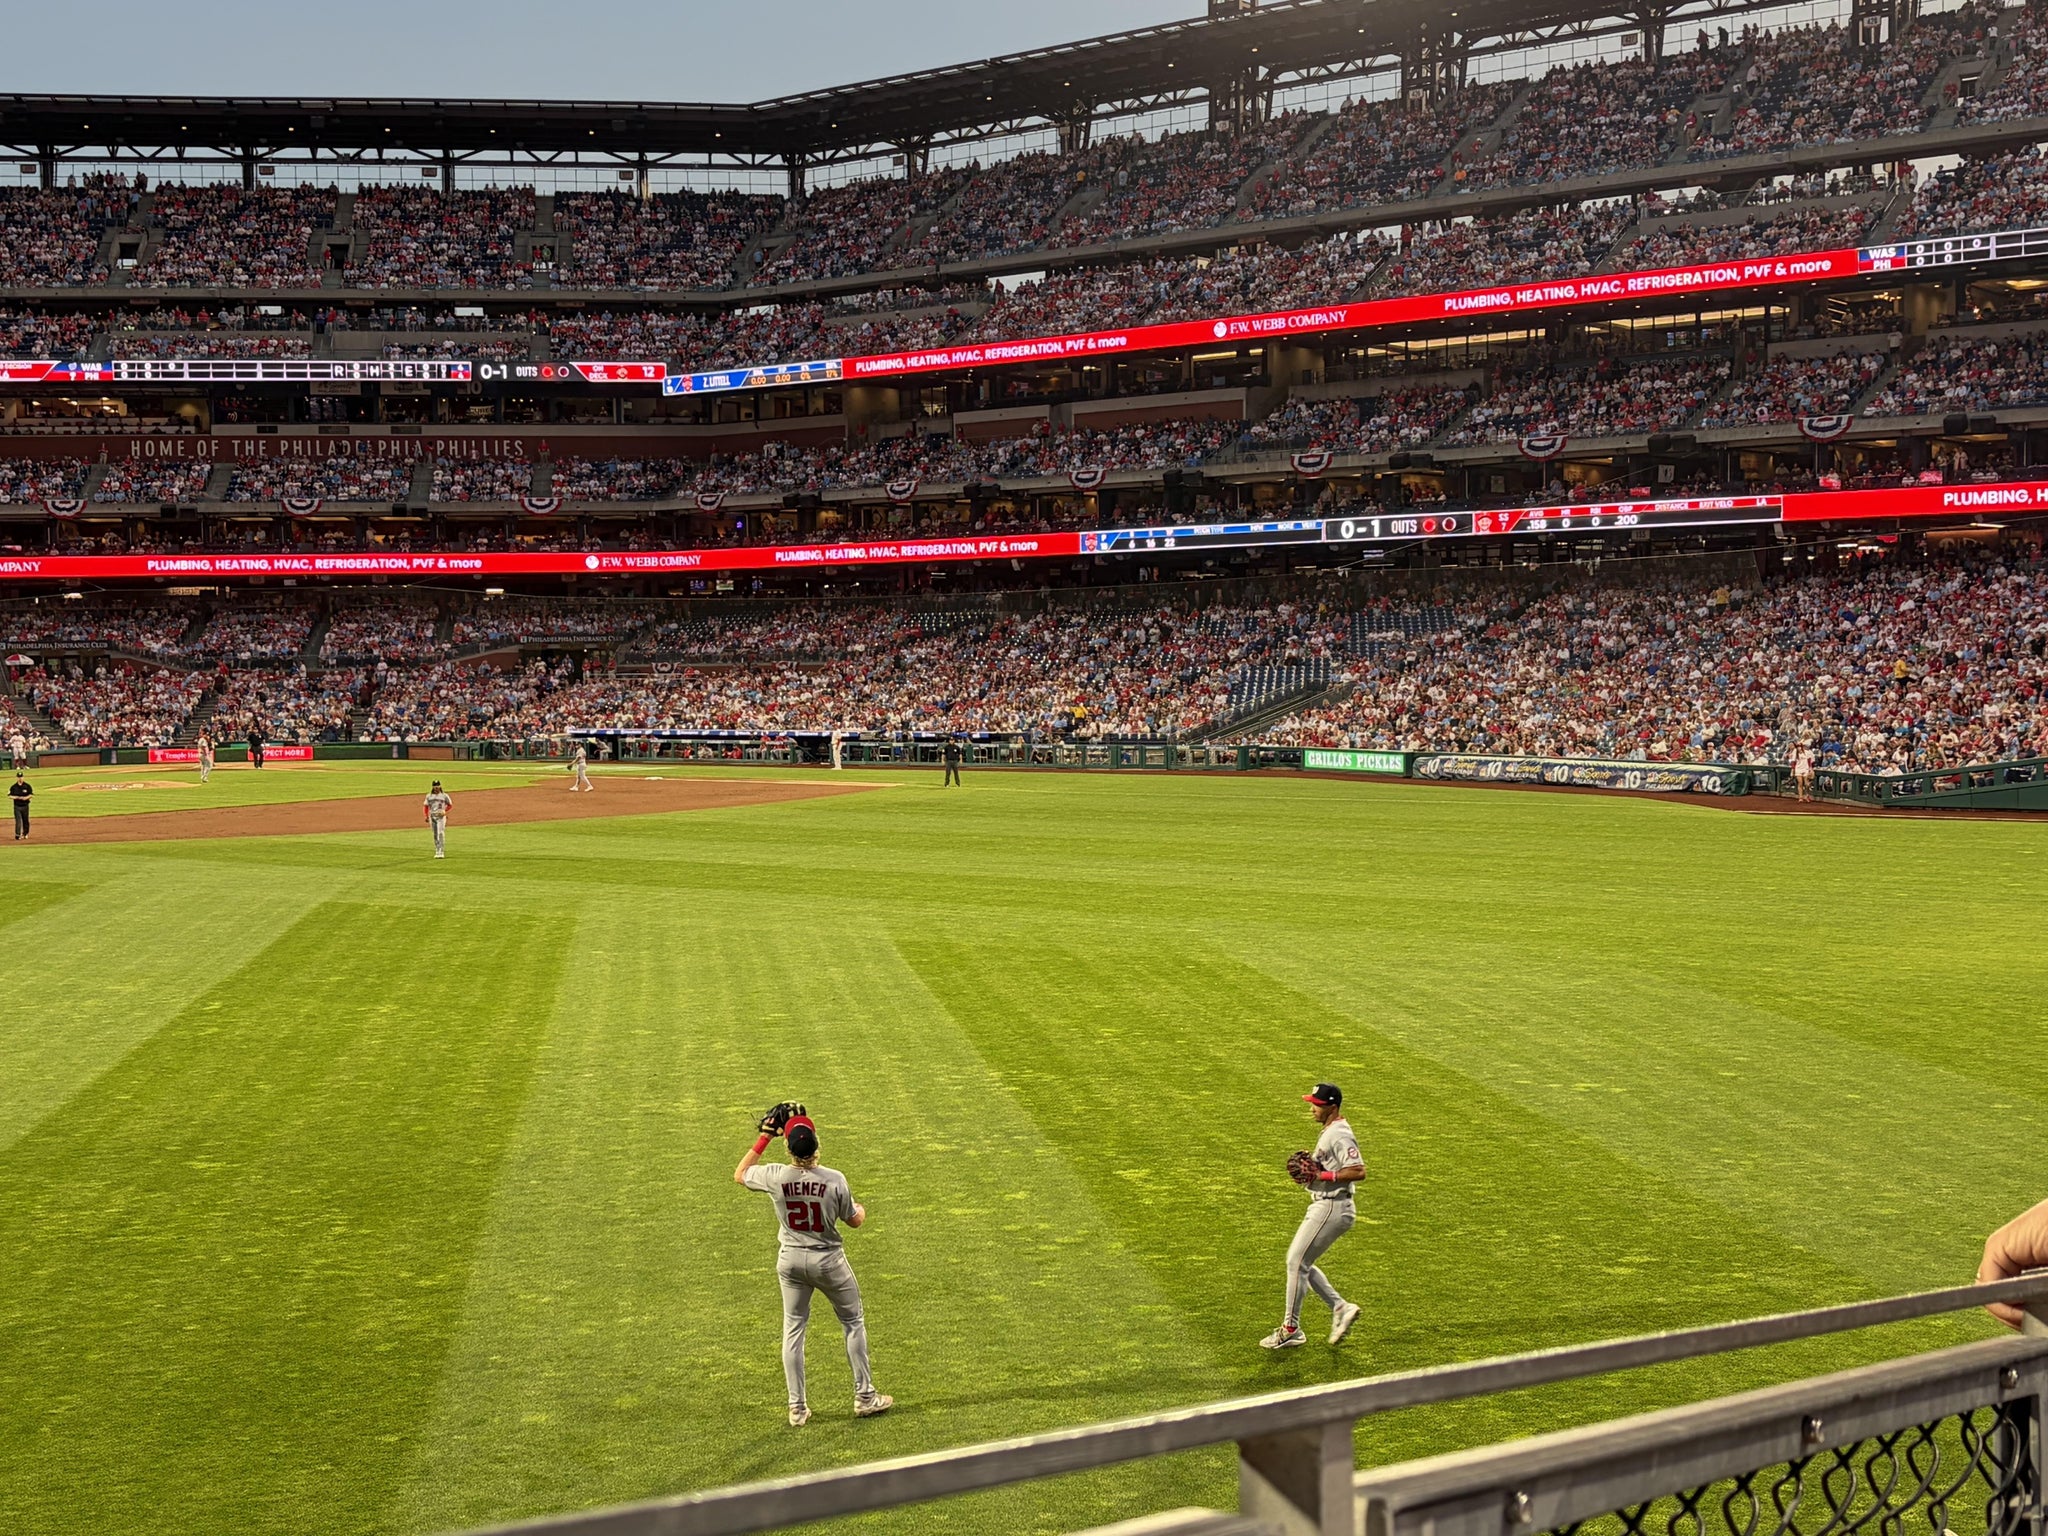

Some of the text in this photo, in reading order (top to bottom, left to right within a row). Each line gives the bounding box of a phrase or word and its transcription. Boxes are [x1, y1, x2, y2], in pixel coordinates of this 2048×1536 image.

[1868, 239, 1982, 260] WAS 0 0 0
[1873, 253, 1953, 270] PHI 0 0
[1444, 259, 1832, 311] PLUMBING, HEATING, HVAC, REFRIGERATION, PVF & more
[1252, 317, 1286, 331] WEBB
[1288, 310, 1347, 328] COMPANY
[856, 335, 1127, 373] PLUMBING, HEATING, HVAC, REFRIGERATION, PVF & more
[334, 365, 344, 377] R
[370, 365, 380, 377] H
[404, 365, 413, 377] E
[516, 366, 539, 377] OUTS
[642, 366, 655, 378] 12
[131, 439, 185, 457] HOME
[197, 439, 220, 457] OF
[231, 439, 267, 457] THE
[280, 439, 424, 457] PHILADEPHIA
[1943, 489, 2033, 506] PLUMBING,
[1498, 513, 1510, 522] SS
[1561, 518, 1570, 528] 0
[1591, 516, 1601, 526] 0
[1391, 519, 1418, 534] OUTS
[1164, 537, 1176, 548] 22
[775, 541, 1039, 562] PLUMBING, HEATING, HVAC, REFRIGERATION, PVF & more
[147, 558, 483, 573] PLUMBING, HEATING, HVAC, REFRIGERATION, PVF & more
[626, 556, 658, 567] WEBB
[660, 555, 701, 567] COMPANY
[285, 748, 305, 757] MORE
[1308, 752, 1402, 770] GRILLO'S PICKLES
[1425, 758, 1441, 775] 10
[1485, 761, 1503, 778] 10
[1552, 765, 1570, 783] 10
[1624, 770, 1642, 789] 10
[1700, 775, 1722, 793] 10
[785, 1200, 825, 1233] 21
